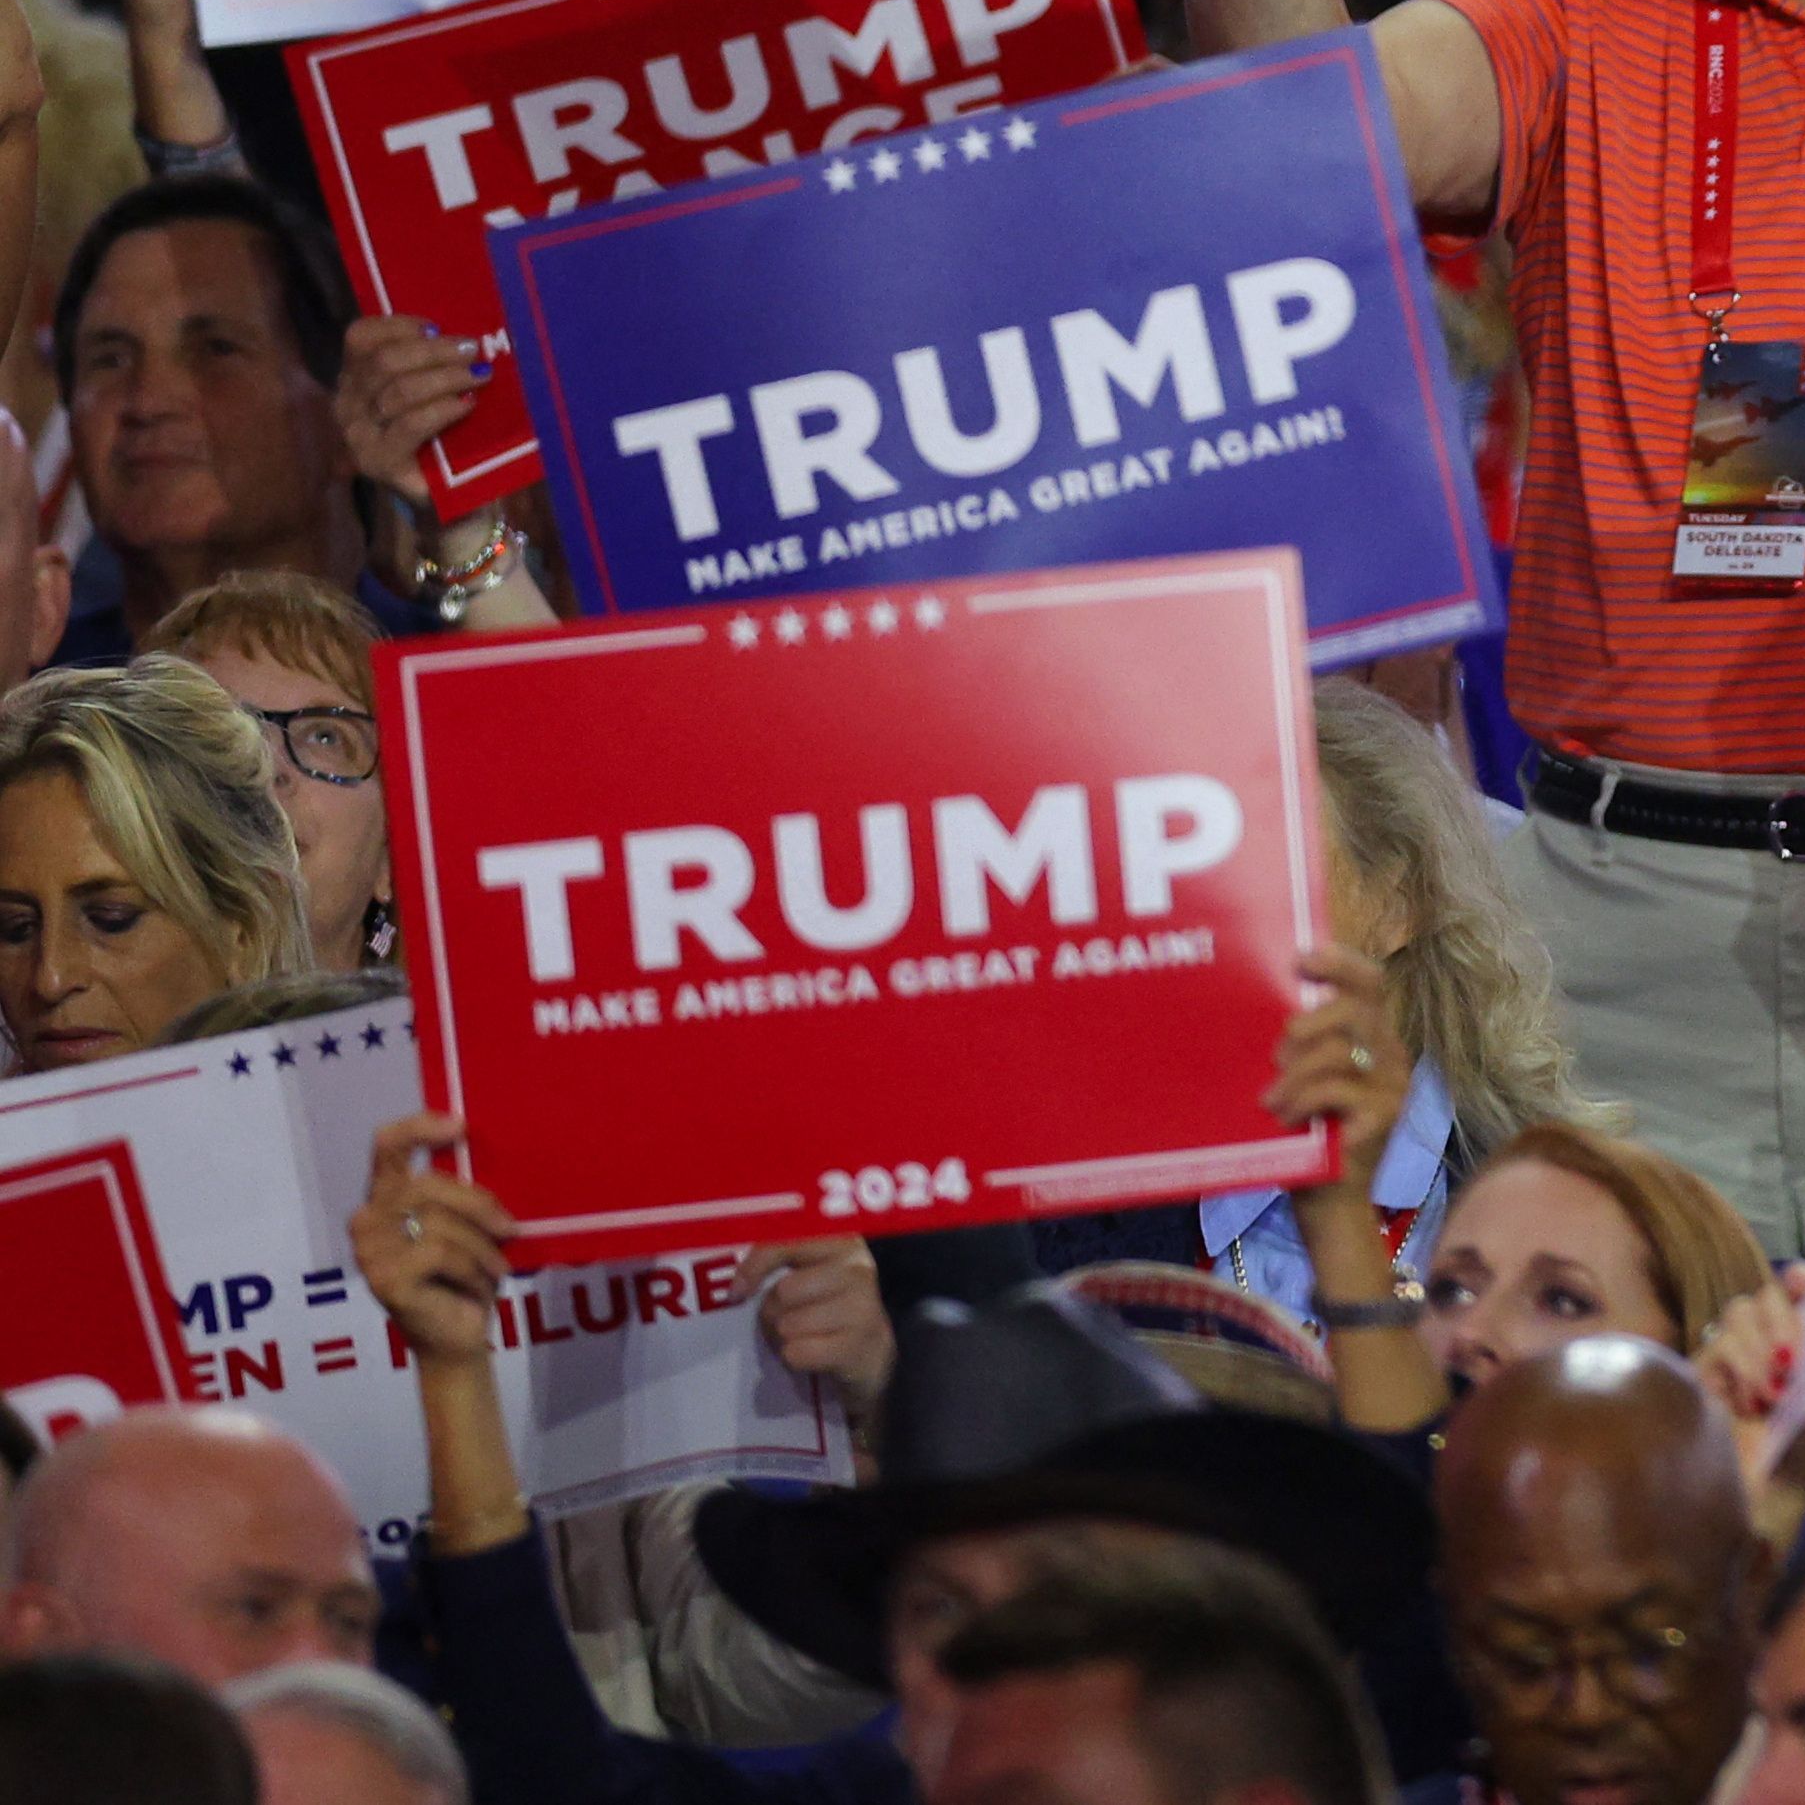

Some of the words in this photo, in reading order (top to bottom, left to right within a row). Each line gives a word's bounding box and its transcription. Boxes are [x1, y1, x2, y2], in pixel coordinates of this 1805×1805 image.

[612, 255, 1358, 542] TRUMP
[684, 532, 807, 593] MAKE
[819, 487, 1020, 565] AMERICA
[1029, 446, 1173, 511] GREAT
[1188, 405, 1346, 475] AGAIN!
[1686, 532, 1737, 542] SOUTH
[1742, 533, 1803, 543] DAKOTA
[1704, 546, 1781, 557] DELEGATE
[476, 771, 1246, 984] TRUMP
[532, 986, 663, 1037] MAKE
[673, 963, 880, 1022] AMERICA
[888, 945, 1038, 996] GREAT
[1052, 927, 1216, 980] AGAIN!
[818, 1159, 971, 1218] 2024
